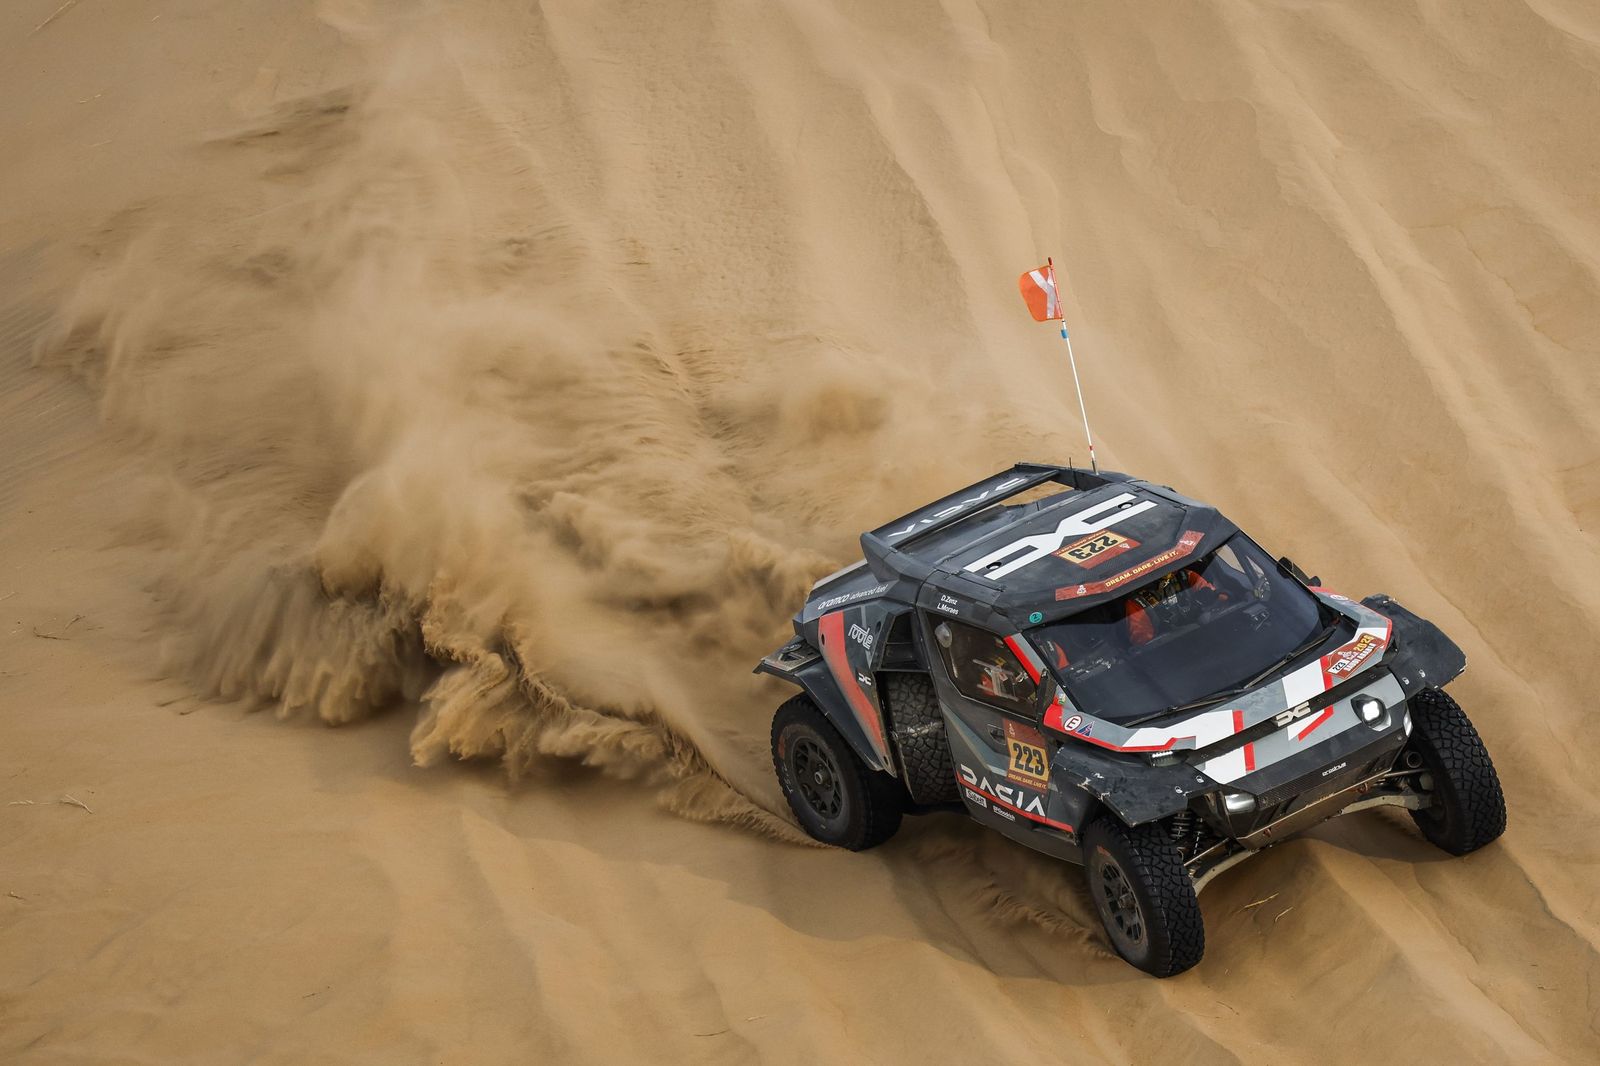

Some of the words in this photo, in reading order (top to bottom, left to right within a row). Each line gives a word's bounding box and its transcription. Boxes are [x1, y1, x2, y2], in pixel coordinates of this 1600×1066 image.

[1068, 535, 1119, 560] 223
[1105, 570, 1132, 588] DREAM.
[1132, 562, 1154, 575] DARE.
[1154, 554, 1170, 565] LIVE
[817, 594, 850, 610] aramco
[850, 587, 877, 600] advanced
[1332, 661, 1346, 671] 223
[1012, 742, 1046, 777] 223
[960, 763, 1046, 817] DACIA
